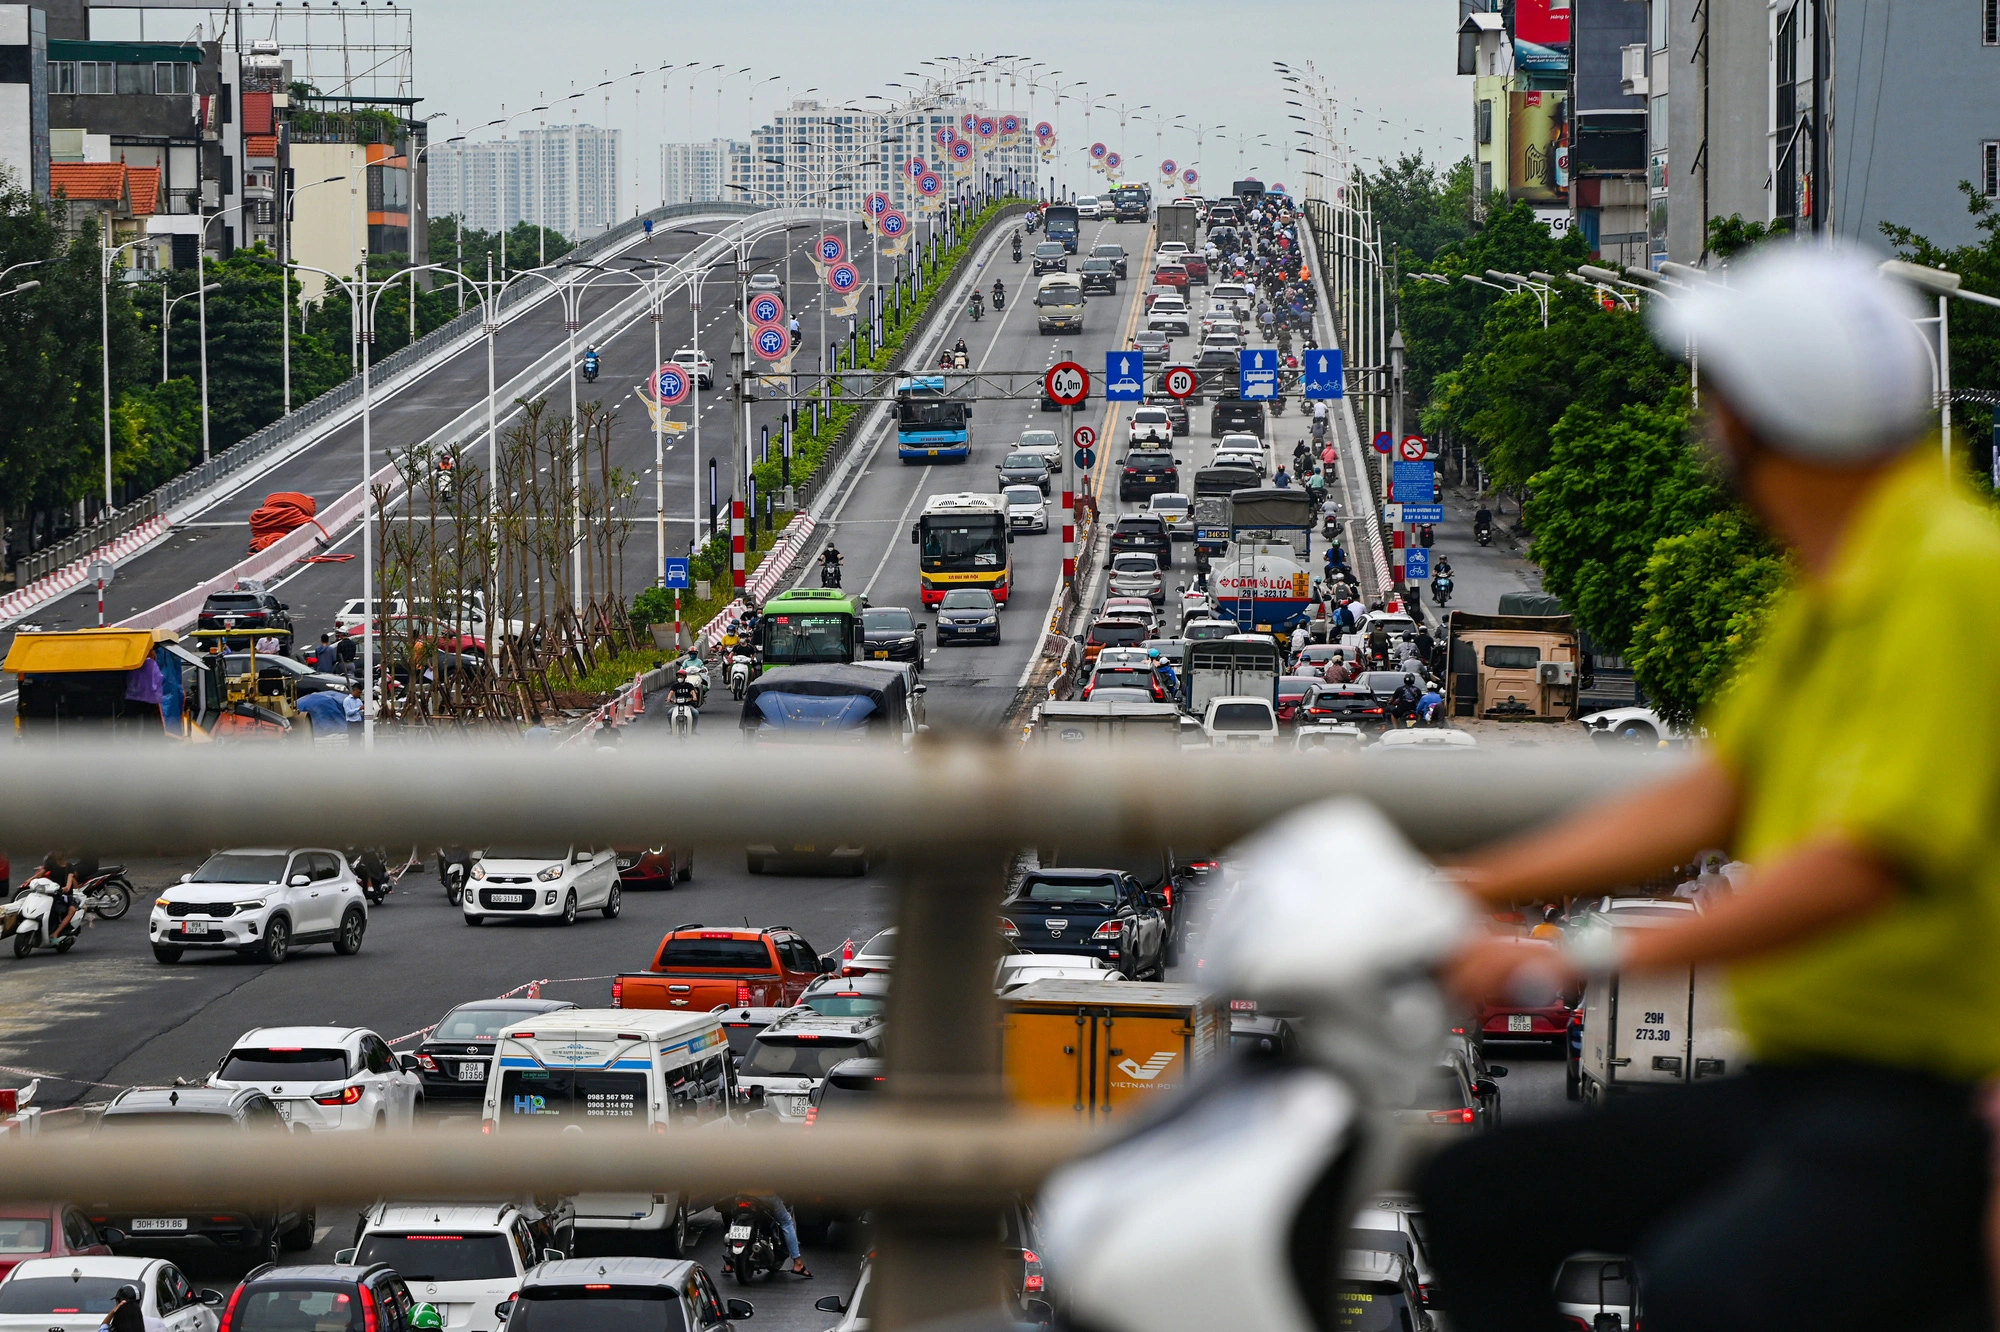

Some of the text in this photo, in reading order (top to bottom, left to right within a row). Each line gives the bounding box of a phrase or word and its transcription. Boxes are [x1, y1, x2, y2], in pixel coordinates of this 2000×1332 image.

[1173, 376, 1187, 390] 50
[1264, 590, 1288, 598] 323.12
[1644, 1011, 1665, 1024] 29H
[1635, 1028, 1670, 1041] 273.30
[464, 1063, 479, 1072] 89A
[1110, 1081, 1154, 1089] VIETNAM
[136, 1219, 183, 1229] 30H-191.86
